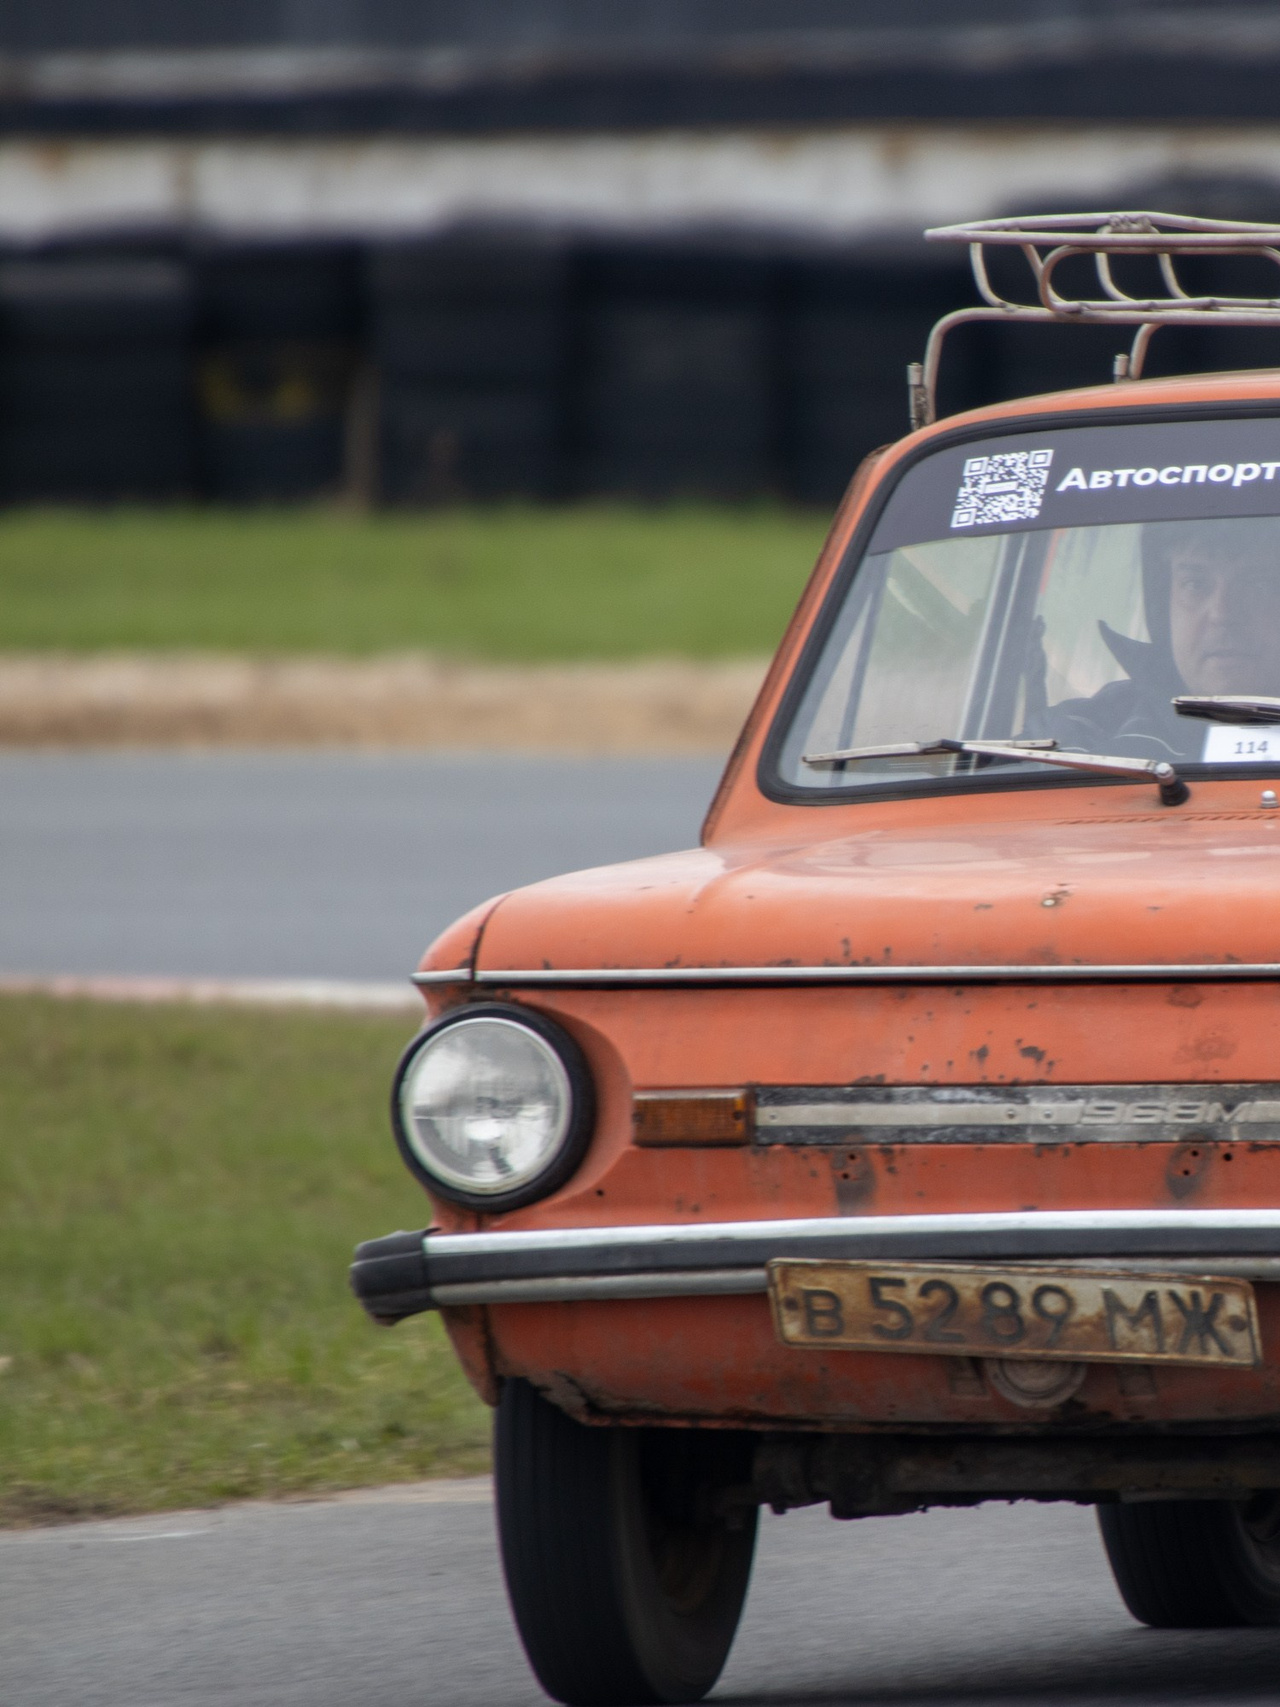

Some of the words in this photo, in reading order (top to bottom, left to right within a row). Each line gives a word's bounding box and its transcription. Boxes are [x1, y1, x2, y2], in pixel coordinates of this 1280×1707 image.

[1233, 739, 1270, 755] 114
[800, 1287, 845, 1339] В
[1101, 1286, 1237, 1357] МЖ
